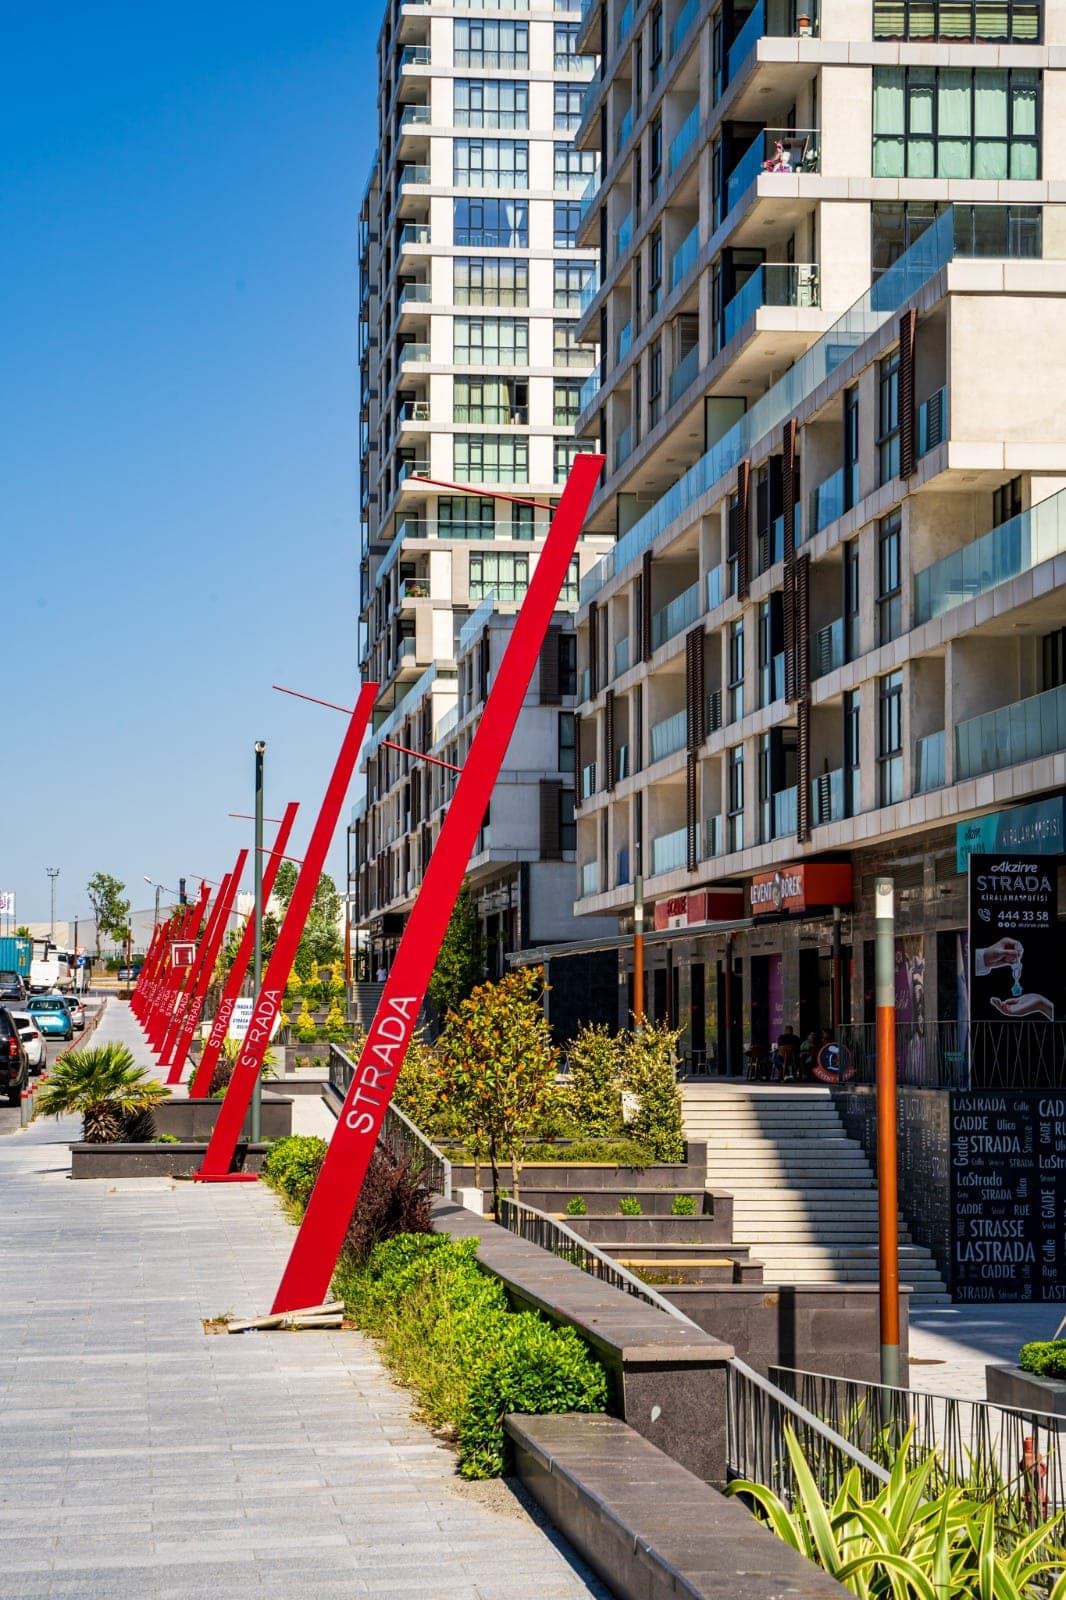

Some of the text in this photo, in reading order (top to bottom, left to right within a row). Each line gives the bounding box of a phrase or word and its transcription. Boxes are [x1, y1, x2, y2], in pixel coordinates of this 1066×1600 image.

[990, 861, 1038, 873] Akzirve
[976, 875, 1052, 892] STRADA
[751, 881, 773, 905] LEVENT
[997, 911, 1049, 921] 444 33 58
[174, 992, 190, 1023] STRADA
[184, 995, 203, 1034] STRADA
[209, 998, 235, 1048] STRADA
[241, 990, 280, 1068] STRADA
[345, 996, 417, 1134] STRADA
[953, 1098, 1006, 1111] LASTRADA
[1039, 1099, 1066, 1117] CAD
[953, 1116, 989, 1130] CADDE
[970, 1135, 1021, 1153] STRADA
[1009, 1158, 1034, 1168] STRADA
[957, 1170, 1002, 1186] LaStrada
[981, 1189, 1012, 1200] STRADA
[956, 1203, 983, 1215] CADDE
[1014, 1204, 1030, 1216] RUE
[970, 1219, 1025, 1237] STRASSE
[956, 1241, 1036, 1262] LASTRADA
[981, 1264, 1016, 1279] CADDE
[957, 1286, 994, 1300] STRADA
[1042, 1285, 1066, 1300] LAST
